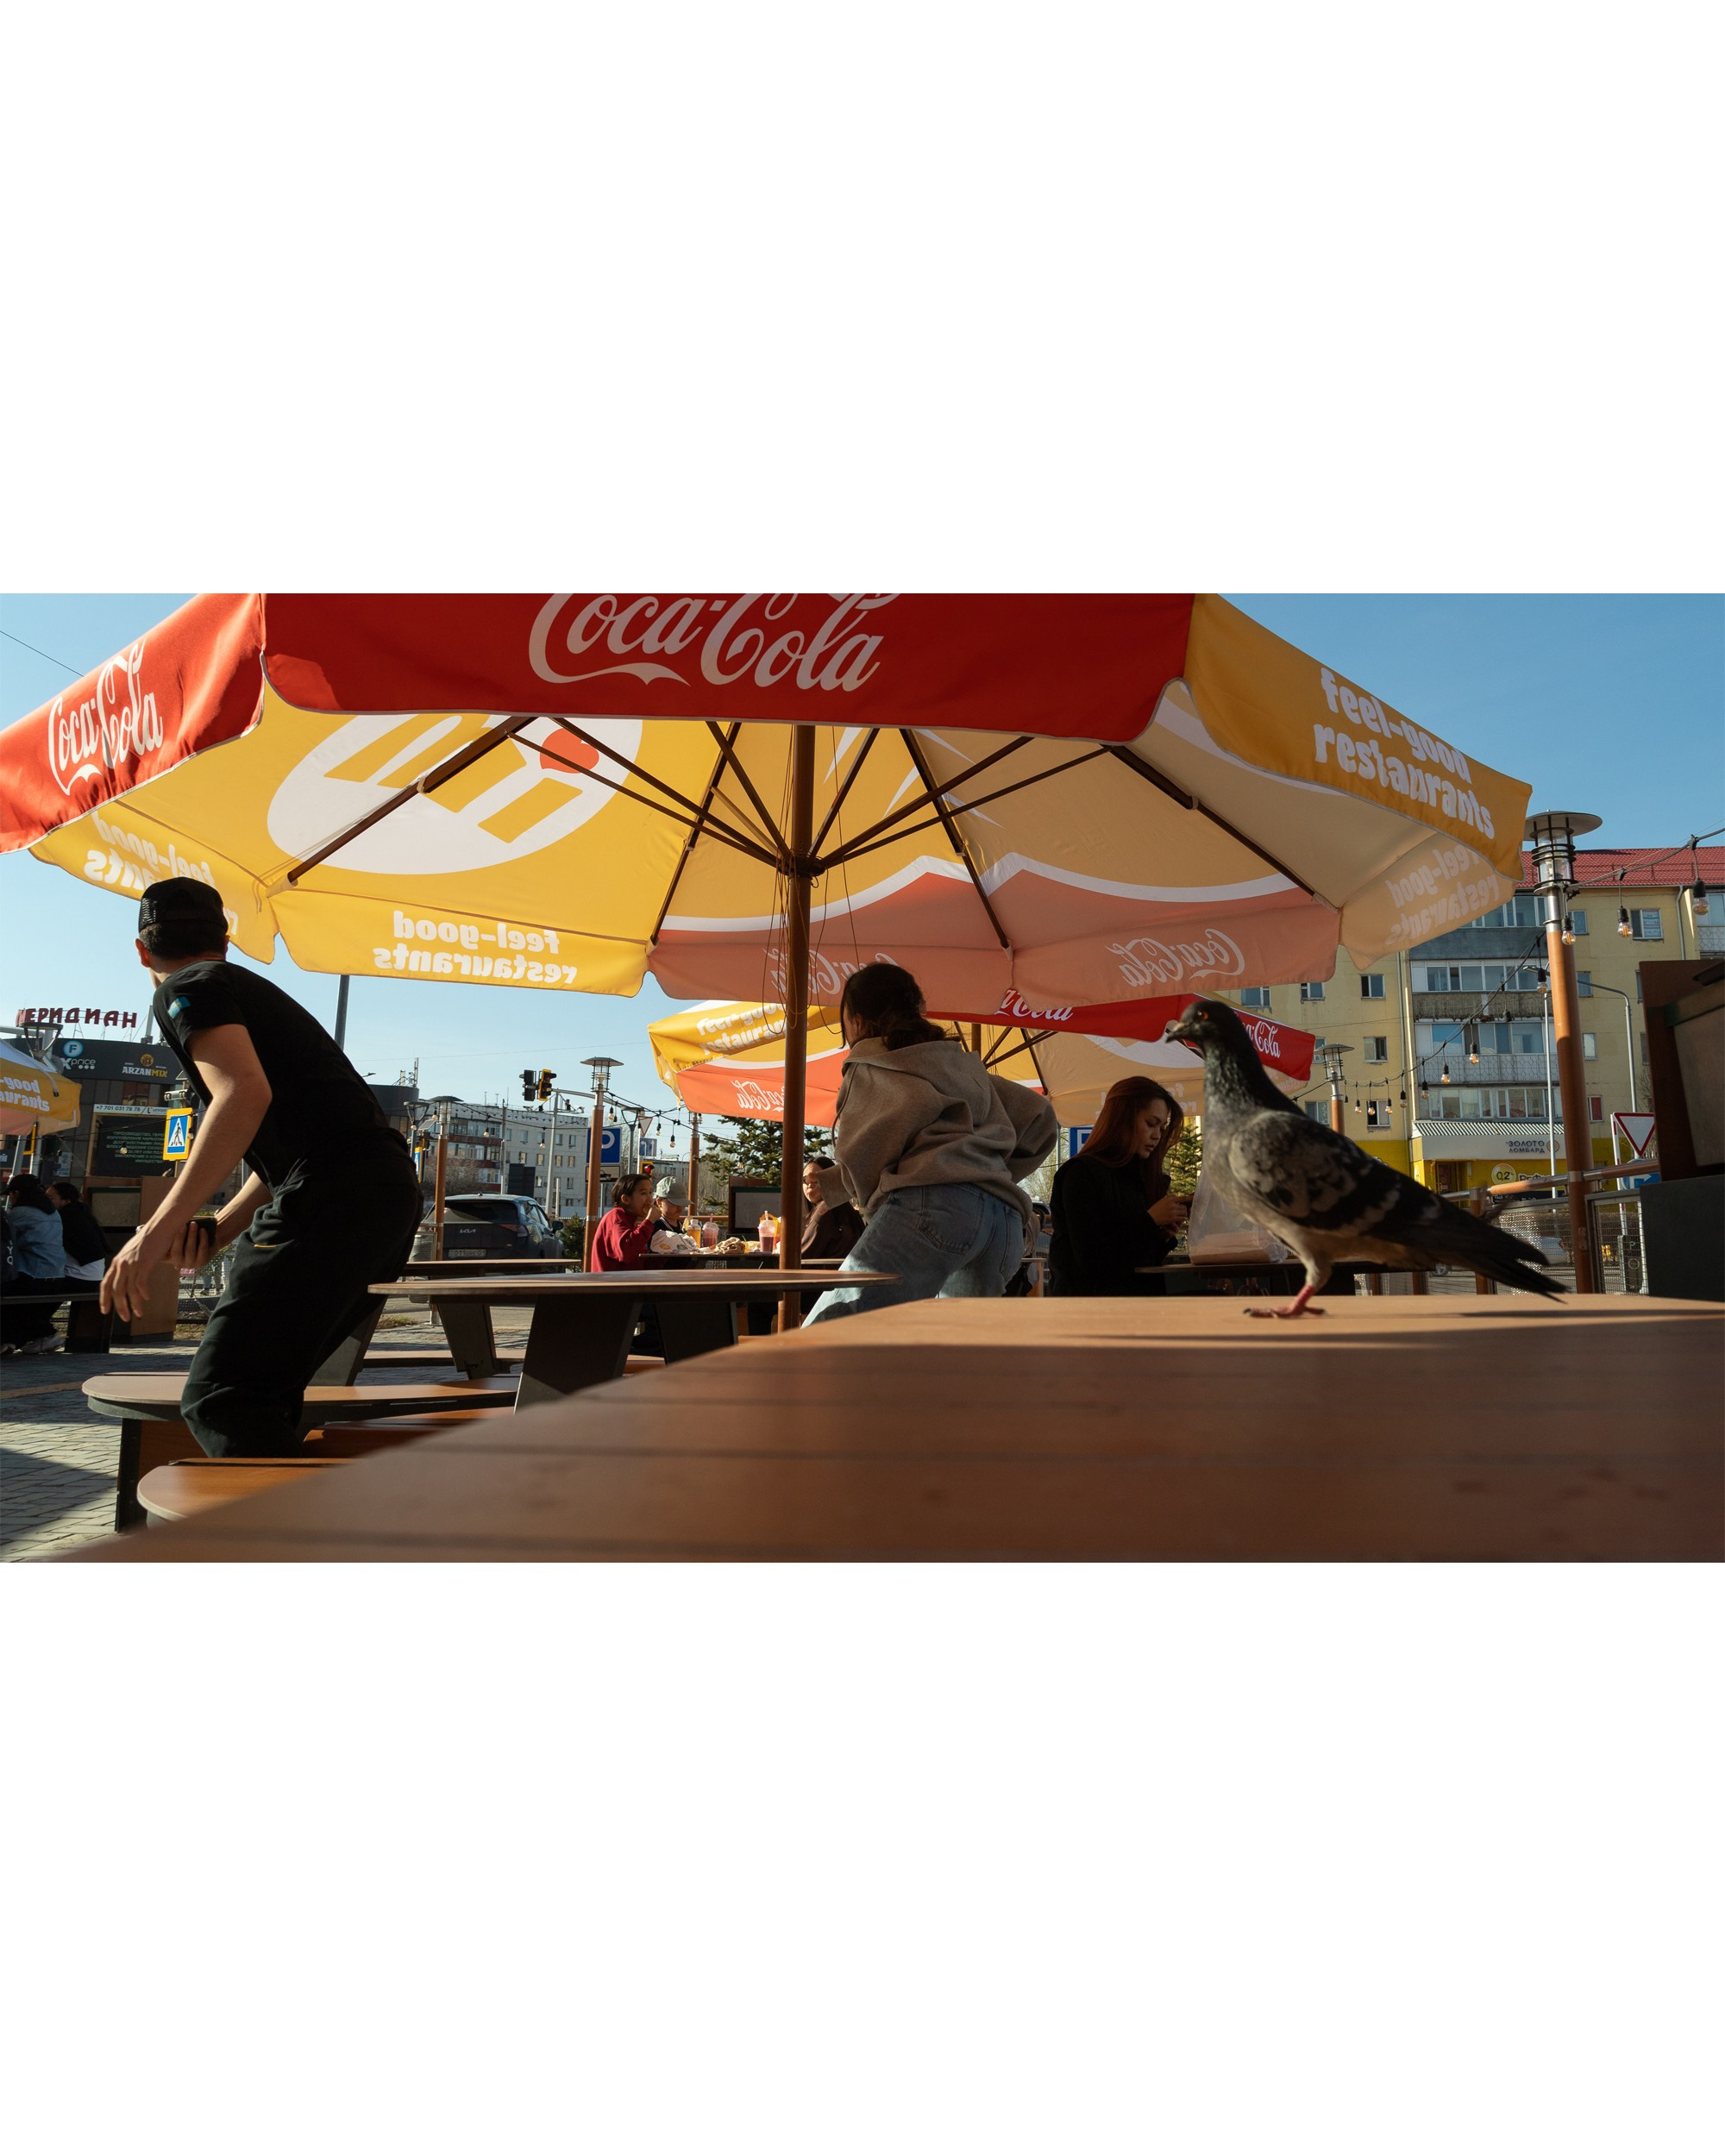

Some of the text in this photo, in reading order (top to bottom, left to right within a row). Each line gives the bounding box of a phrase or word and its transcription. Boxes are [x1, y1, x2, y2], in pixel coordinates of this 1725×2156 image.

[529, 593, 902, 692] Coca-Cola
[48, 639, 164, 795] Coca-Cola
[1320, 667, 1472, 784] feel-good
[1314, 724, 1495, 839] restaurants
